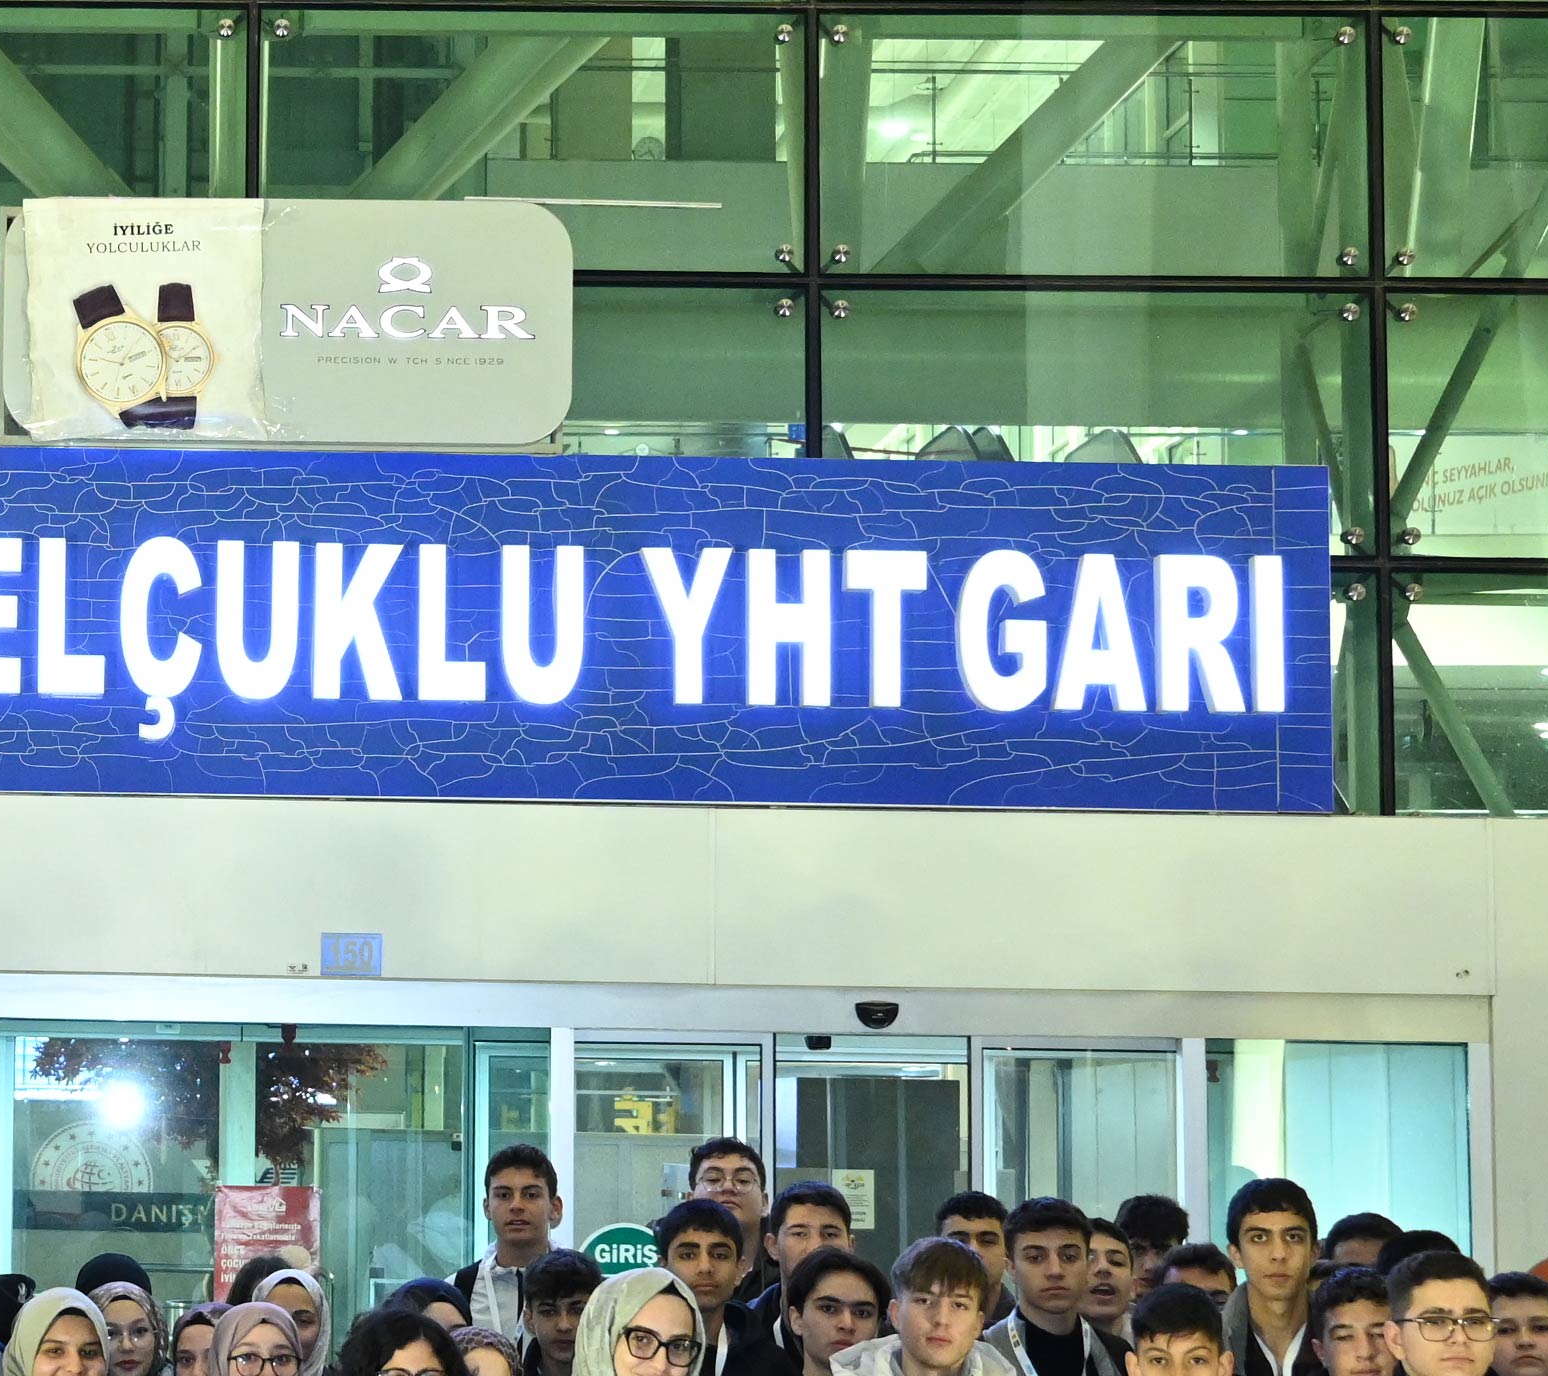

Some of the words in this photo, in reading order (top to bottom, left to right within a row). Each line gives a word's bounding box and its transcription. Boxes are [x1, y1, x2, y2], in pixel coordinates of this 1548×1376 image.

[113, 222, 174, 236] İYİLİĞE
[86, 240, 202, 254] YOLCULUKLAR
[280, 304, 536, 340] NACAR
[317, 356, 381, 365] PRECISION
[388, 357, 428, 365] WTCH
[435, 357, 471, 366] SNCE
[474, 357, 505, 366] 1929
[1410, 489, 1465, 512] OLUNUZ
[1467, 482, 1497, 503] AÇIK
[639, 546, 927, 708] YHT
[953, 549, 1286, 713] GARI
